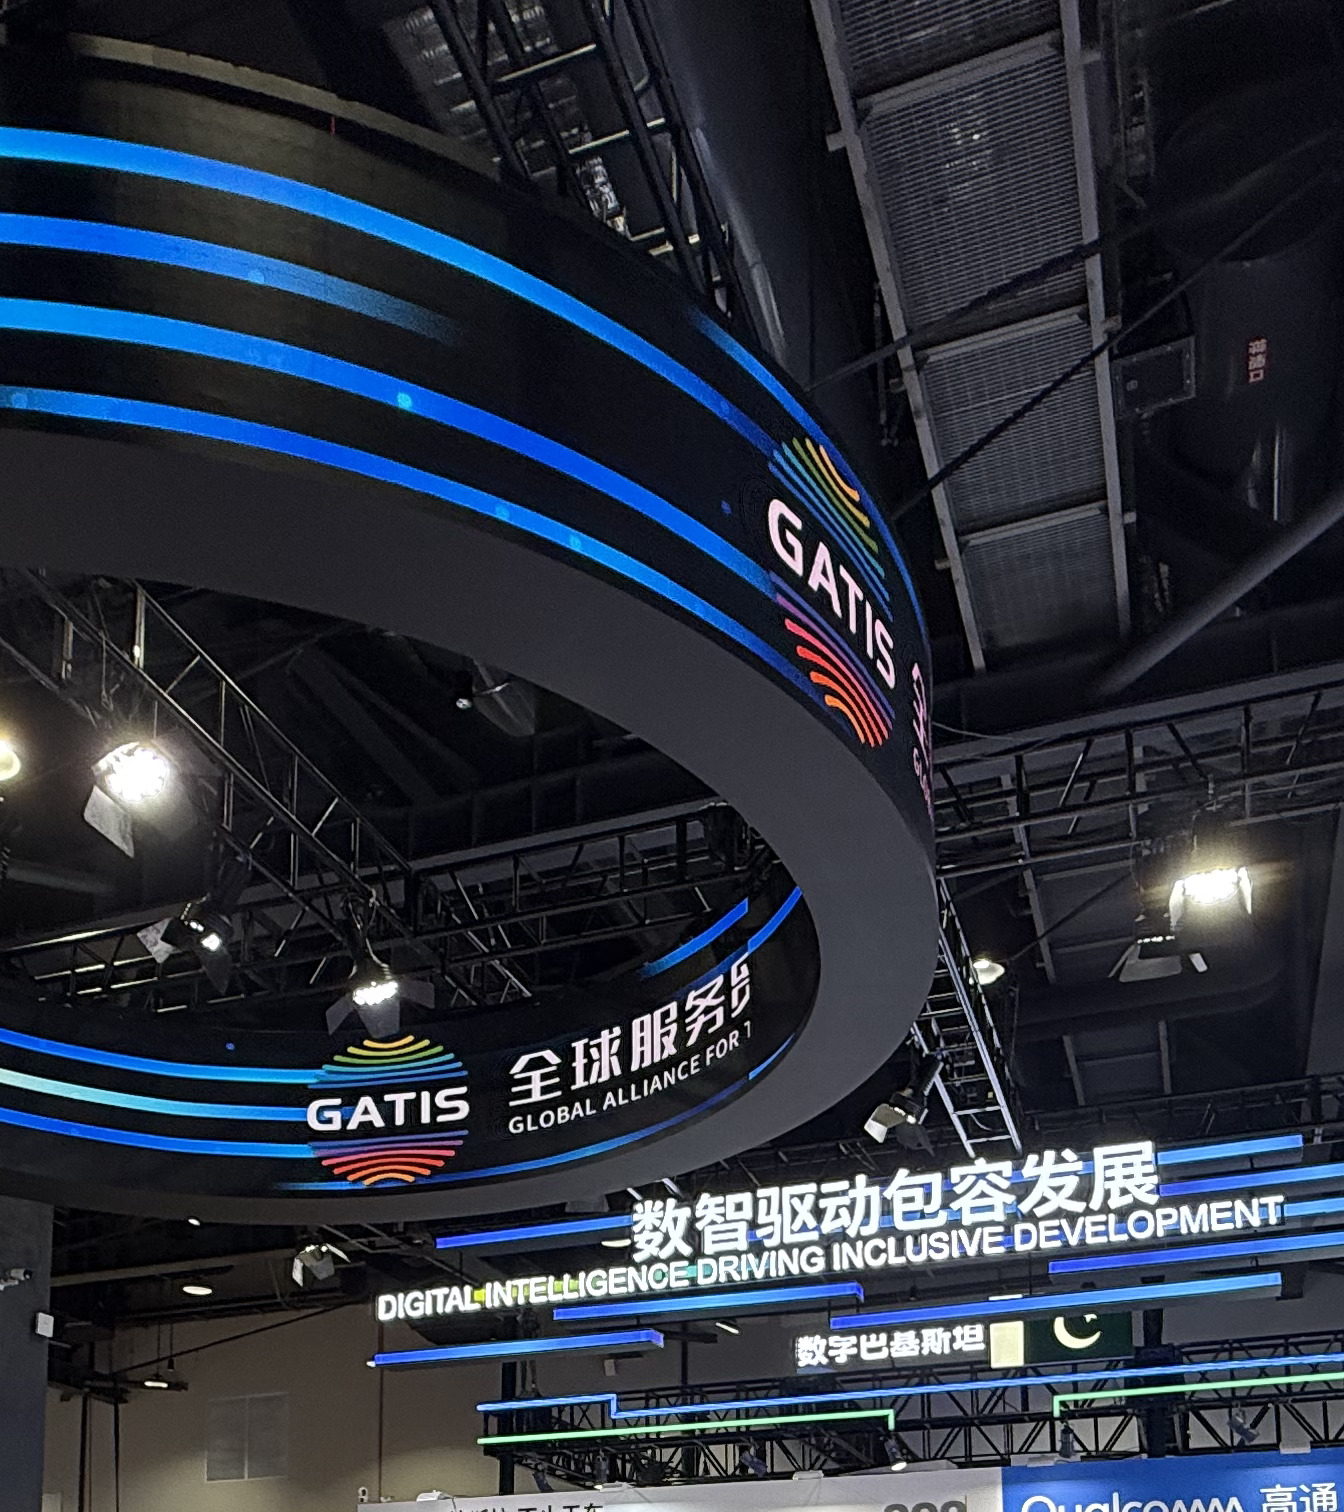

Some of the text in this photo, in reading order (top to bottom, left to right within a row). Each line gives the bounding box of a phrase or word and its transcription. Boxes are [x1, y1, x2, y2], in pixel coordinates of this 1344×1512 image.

[768, 499, 896, 689] GATIS
[307, 1086, 469, 1131] GATIS
[509, 1101, 597, 1135] GLOBAL
[604, 1055, 701, 1110] ALLIANCE
[706, 1030, 739, 1068] FOR
[376, 1195, 1285, 1321] DIGITAL INTELLIGENCE DRIVING INCLUSIVE DEVELOPMENT
[633, 1140, 1159, 1263] 数智驱动包容发展
[796, 1323, 986, 1367] 数字巴基斯坦
